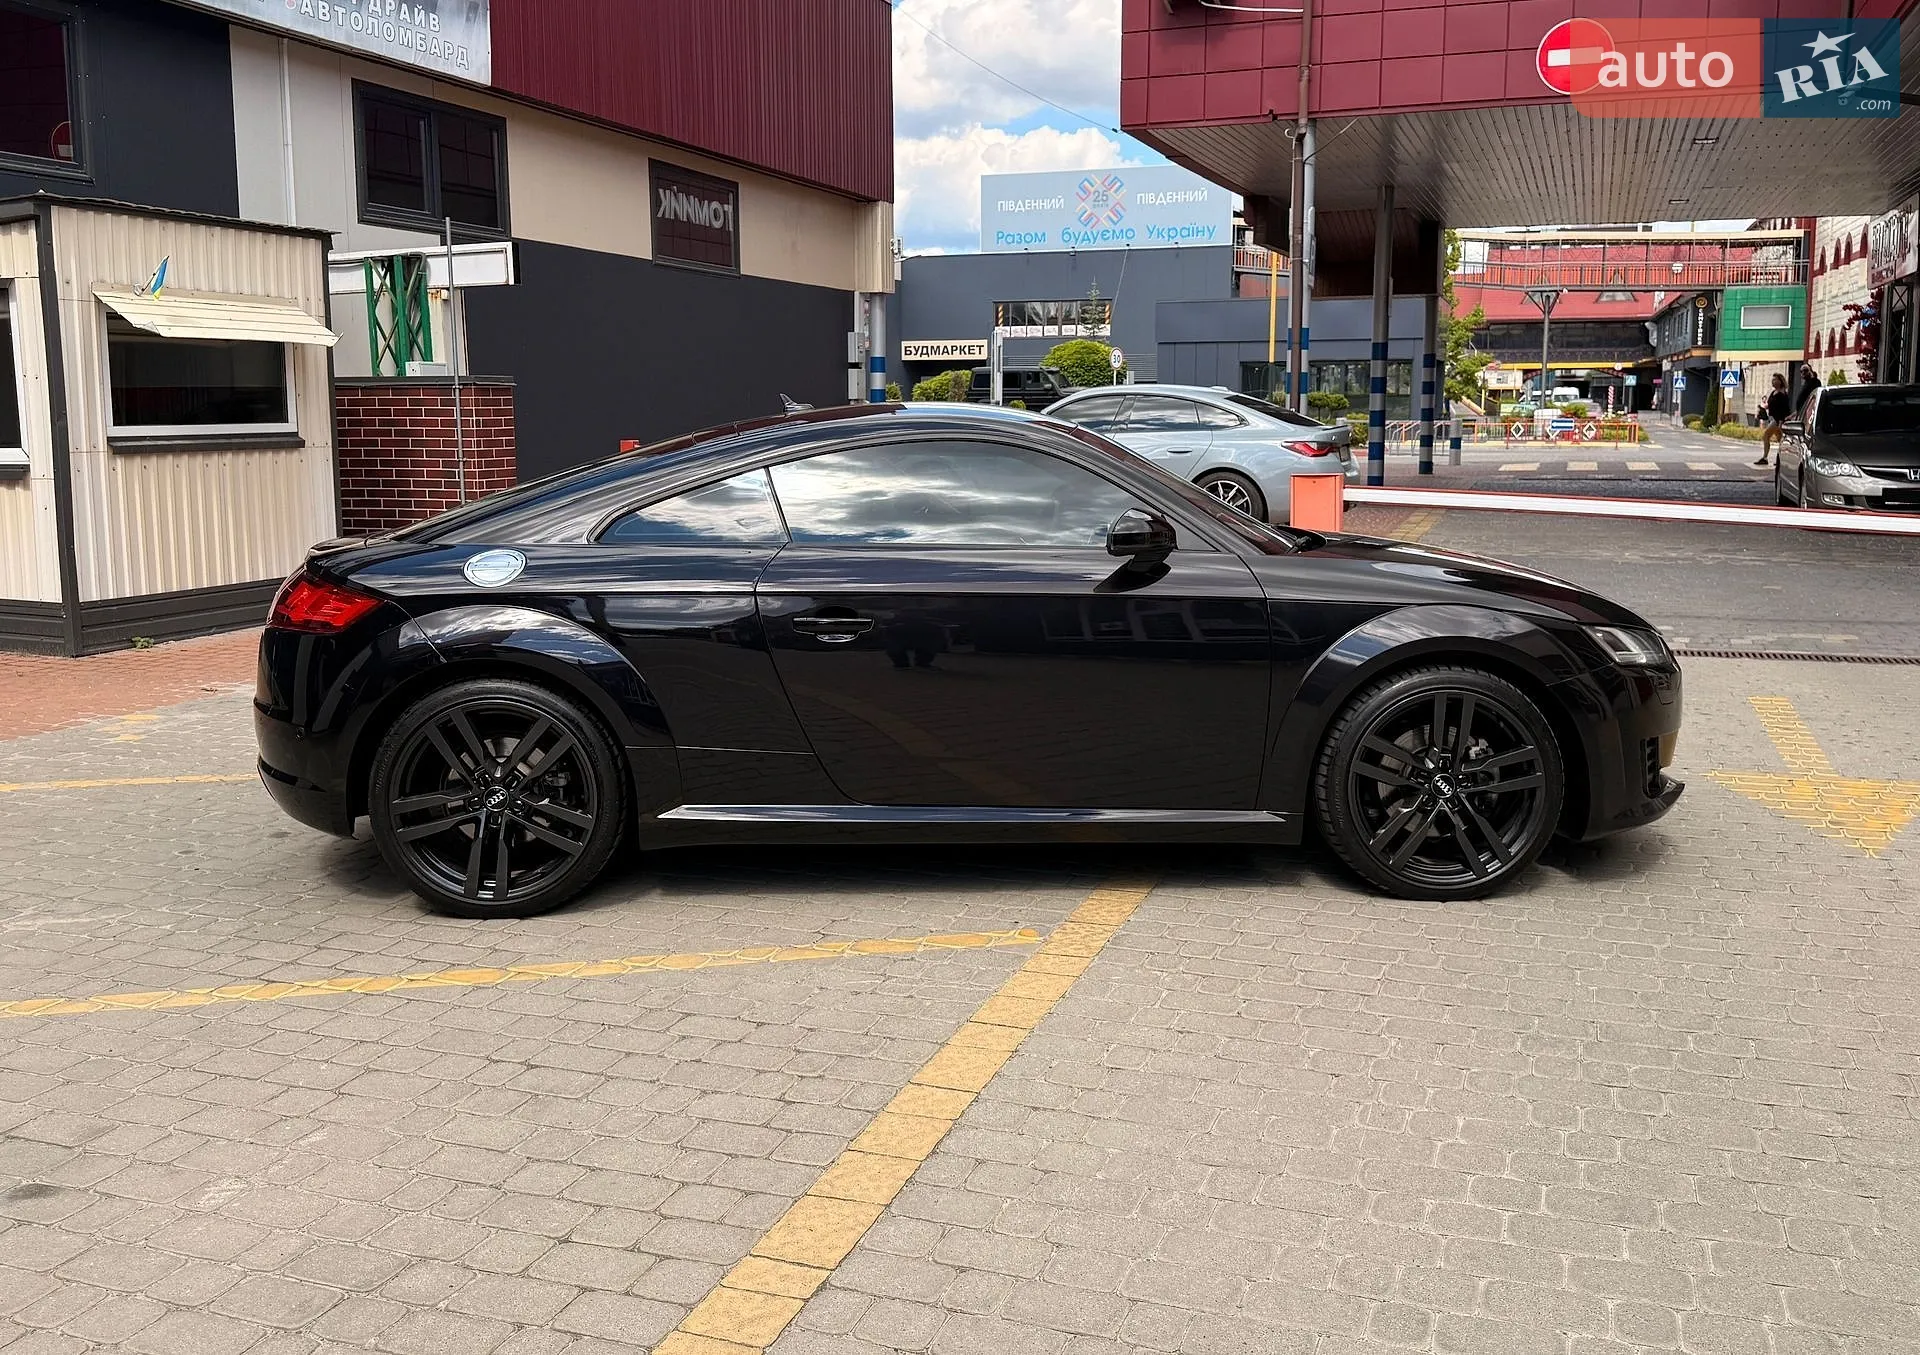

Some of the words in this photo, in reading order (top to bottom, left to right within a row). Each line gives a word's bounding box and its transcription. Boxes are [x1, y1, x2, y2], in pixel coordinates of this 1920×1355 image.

[368, 0, 441, 32] ДРАЙВ
[300, 0, 470, 70] АВТОЛОМБАРД
[998, 194, 1064, 213] ПІВДЕННИЙ
[1093, 190, 1108, 202] 25
[1136, 187, 1208, 206] ПІВДЕННИЙ
[996, 230, 1046, 245] Разом
[1061, 225, 1135, 247] будуємо
[1146, 223, 1216, 244] Україну
[904, 344, 984, 358] БУДМАРКЕТ
[1113, 354, 1121, 363] 30
